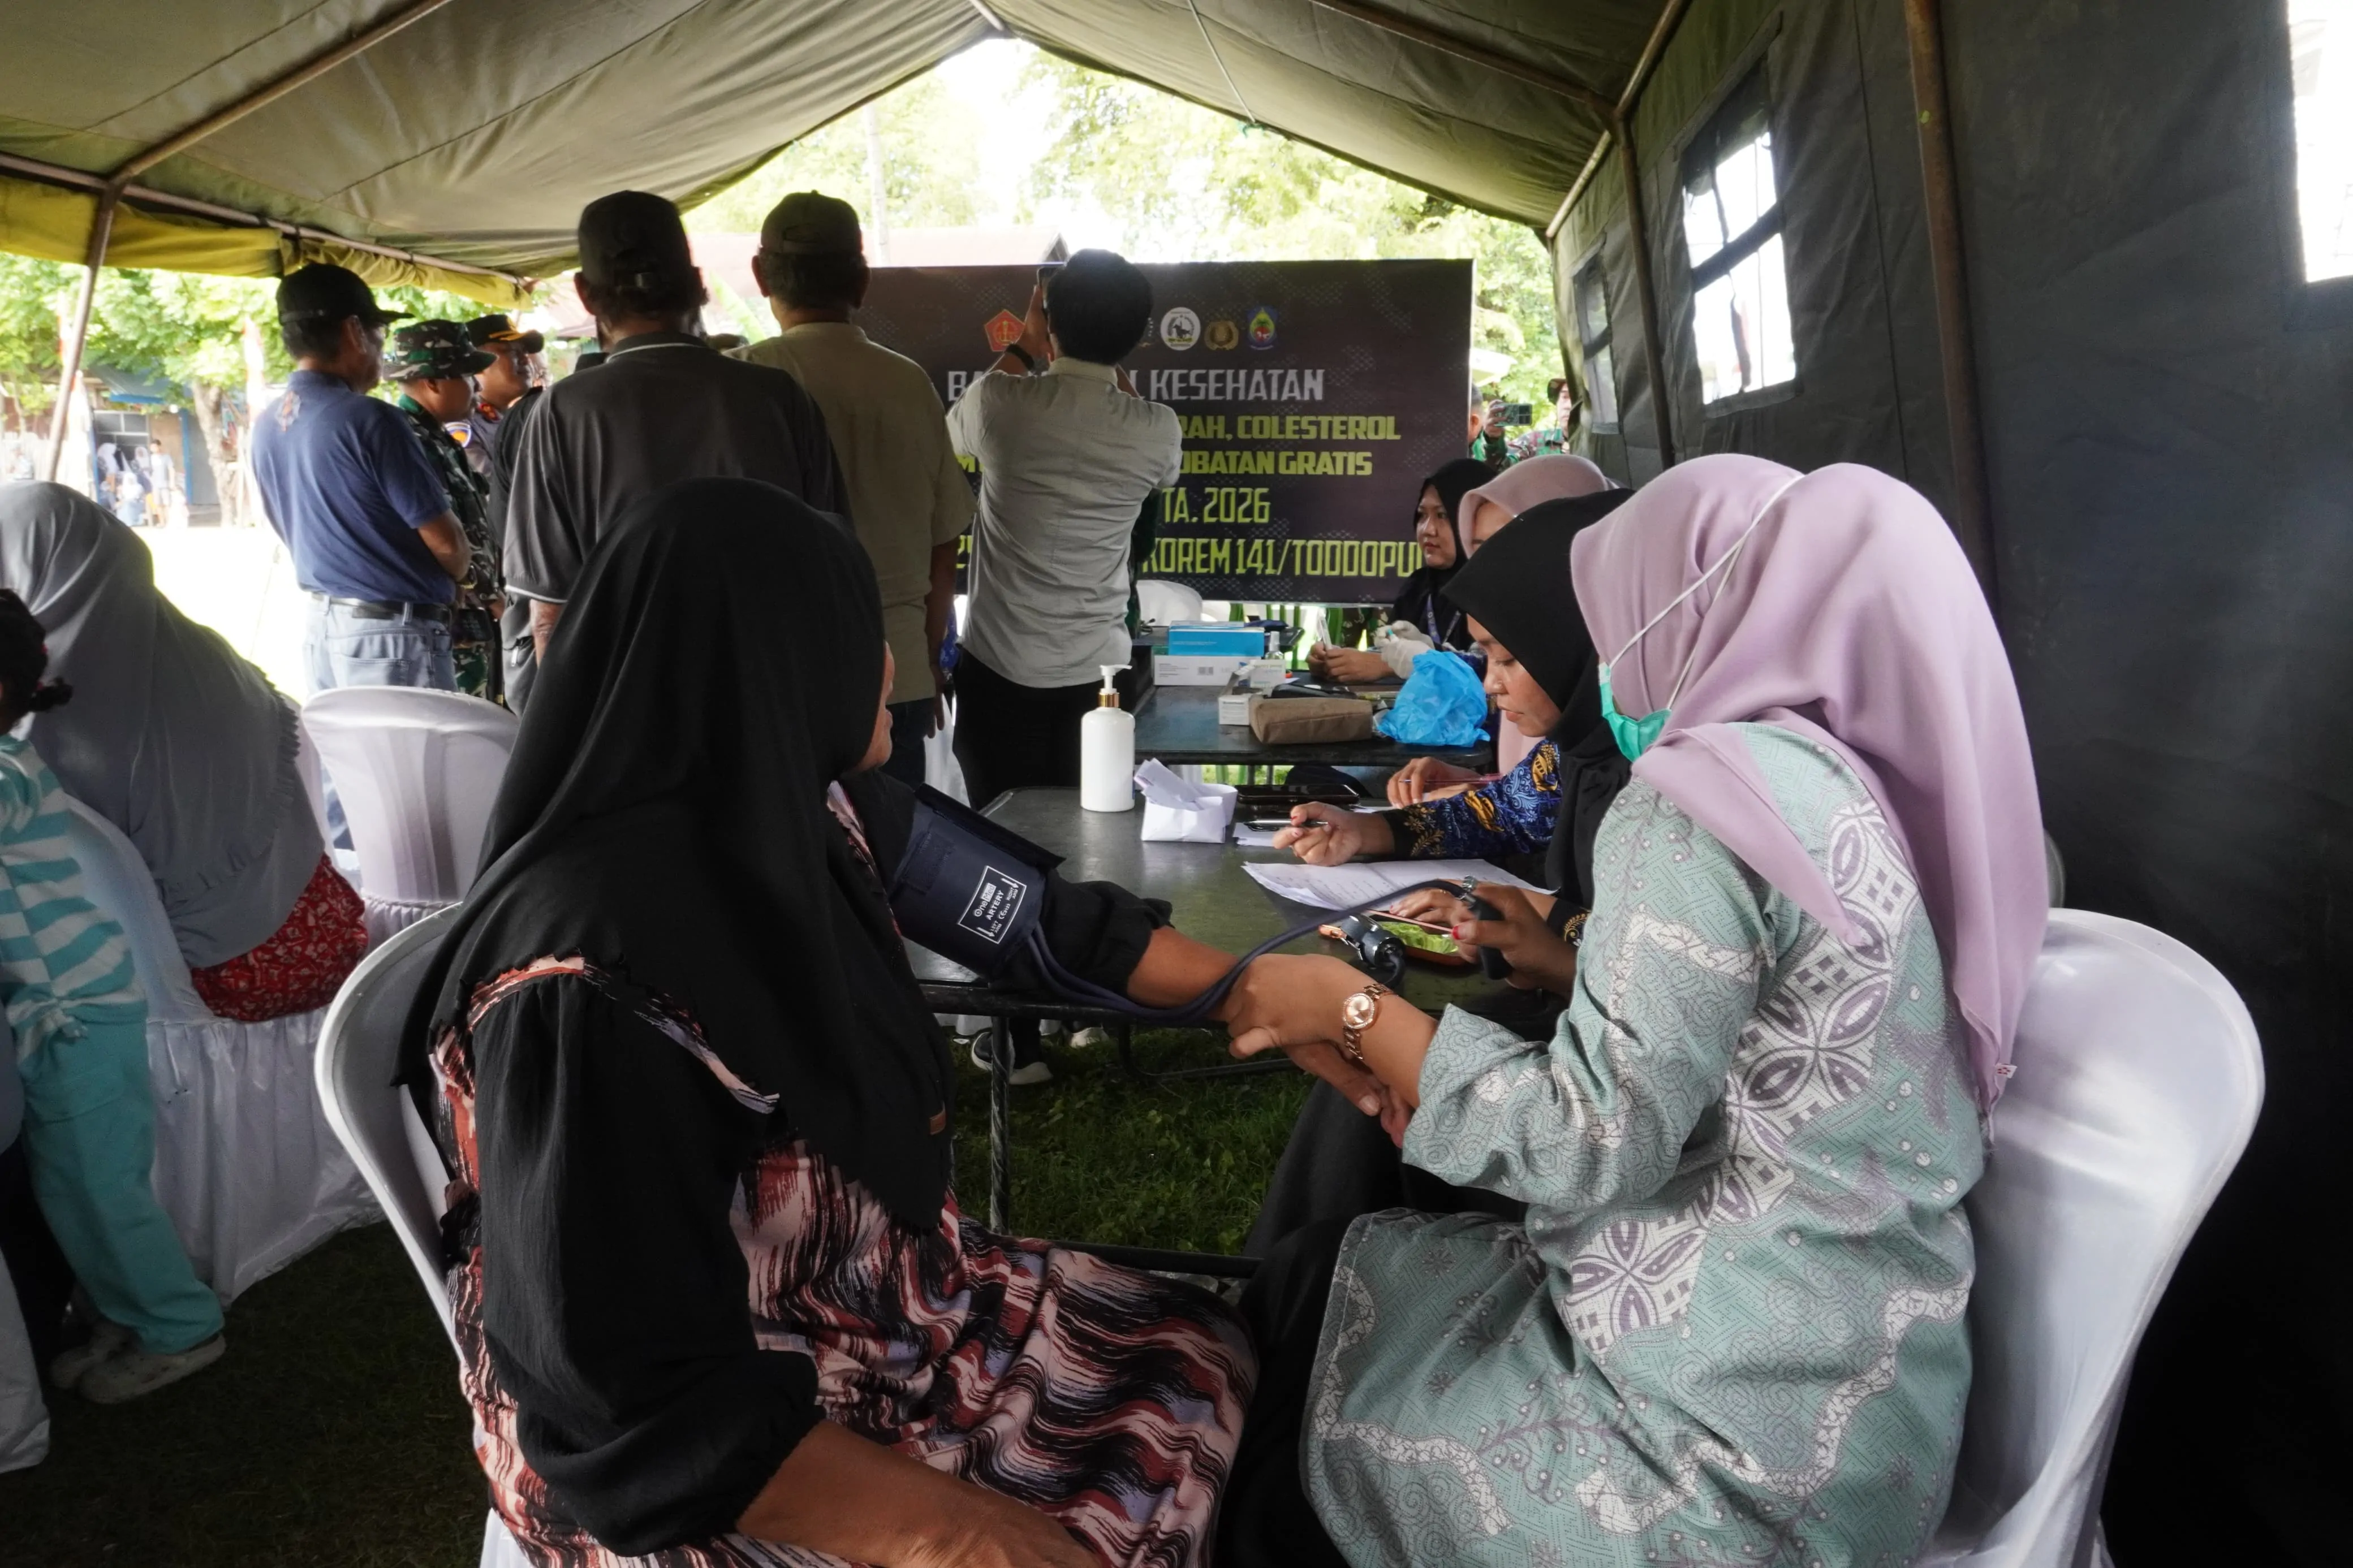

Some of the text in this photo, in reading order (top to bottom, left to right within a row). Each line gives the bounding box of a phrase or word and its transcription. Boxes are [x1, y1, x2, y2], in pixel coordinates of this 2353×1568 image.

[1150, 369, 1325, 401] KESEHATAN
[1177, 415, 1402, 441] RAH, COLESTEROL
[1179, 451, 1373, 476] OBATAN GRATIS
[1161, 487, 1272, 524] TA. 2026
[974, 883, 997, 917] OneMed
[986, 889, 1004, 921] ARTERY
